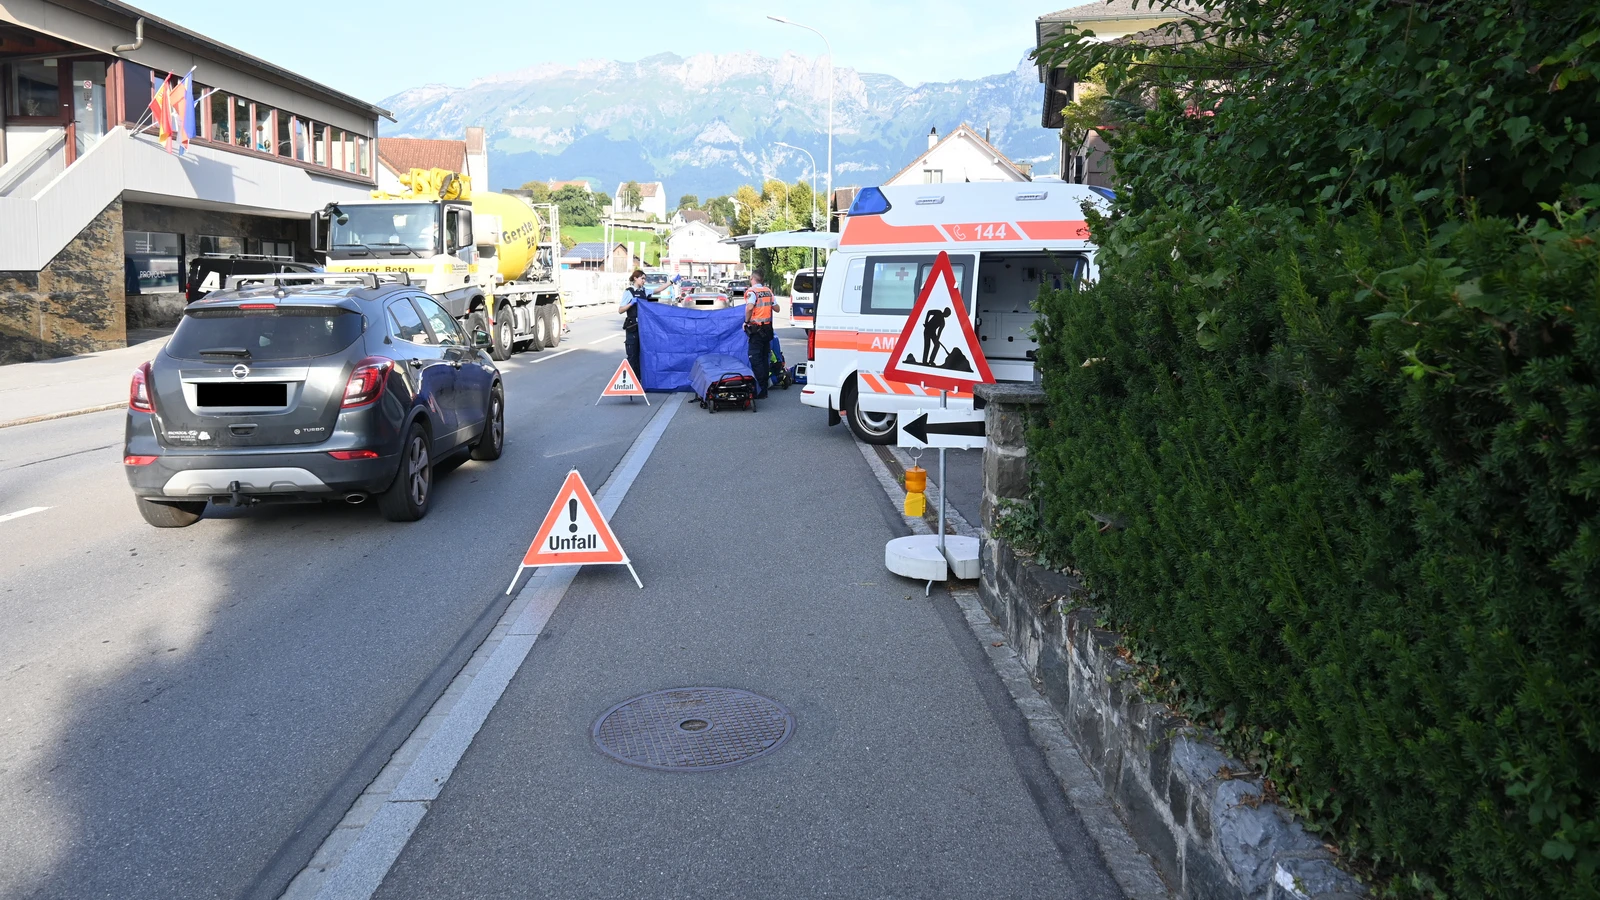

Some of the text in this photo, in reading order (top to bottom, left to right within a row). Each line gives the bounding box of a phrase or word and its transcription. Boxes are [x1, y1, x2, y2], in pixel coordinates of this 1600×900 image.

[974, 223, 1007, 240] 144
[385, 265, 415, 273] Beton
[549, 534, 597, 551] Unfall
